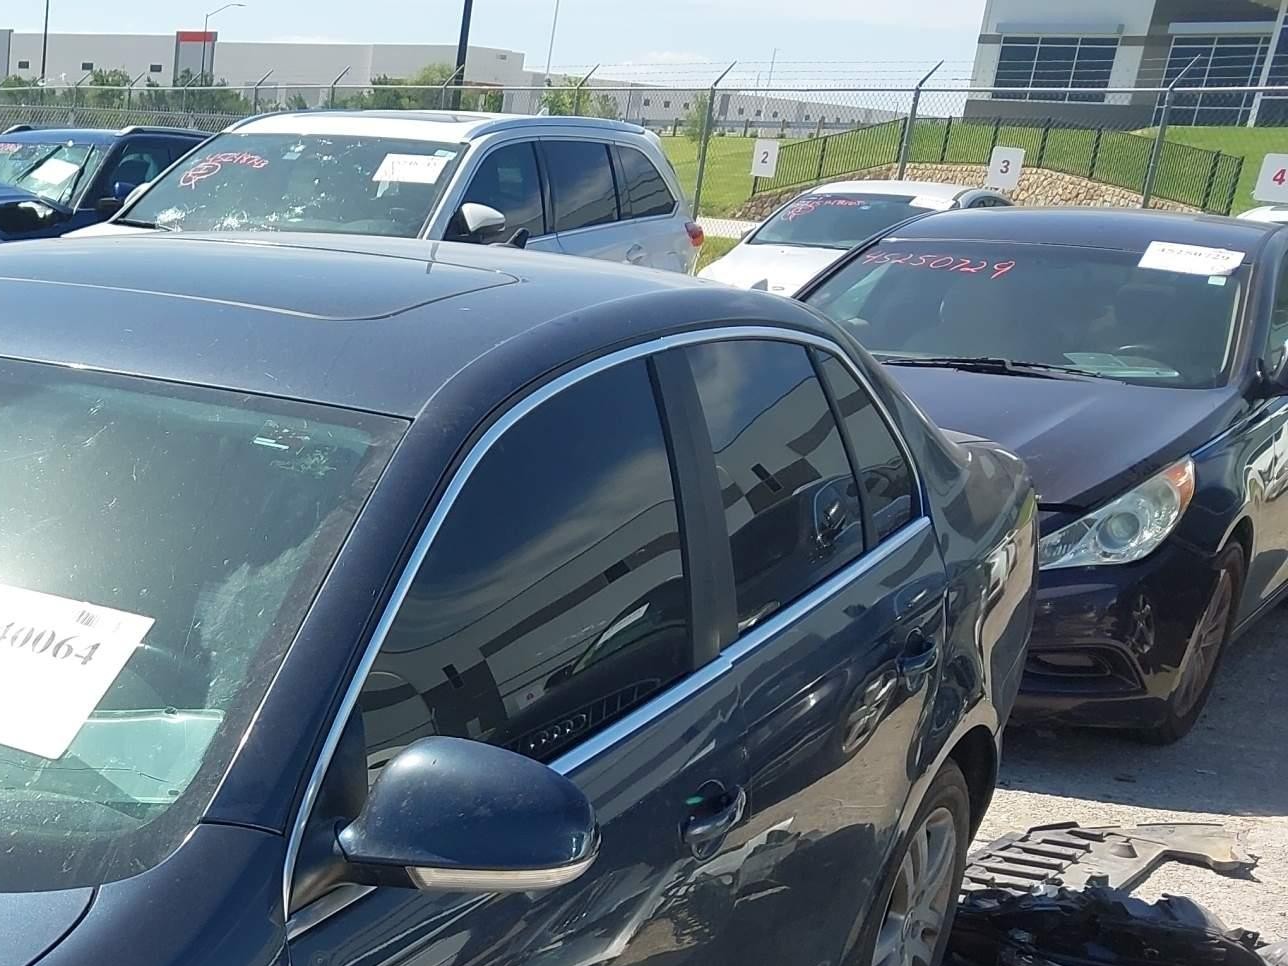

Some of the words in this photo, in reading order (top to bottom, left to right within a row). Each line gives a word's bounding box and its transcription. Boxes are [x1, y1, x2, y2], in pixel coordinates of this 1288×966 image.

[760, 151, 769, 164] 2
[999, 159, 1010, 174] 3
[1272, 168, 1287, 186] 4
[862, 251, 1016, 280] 45250729
